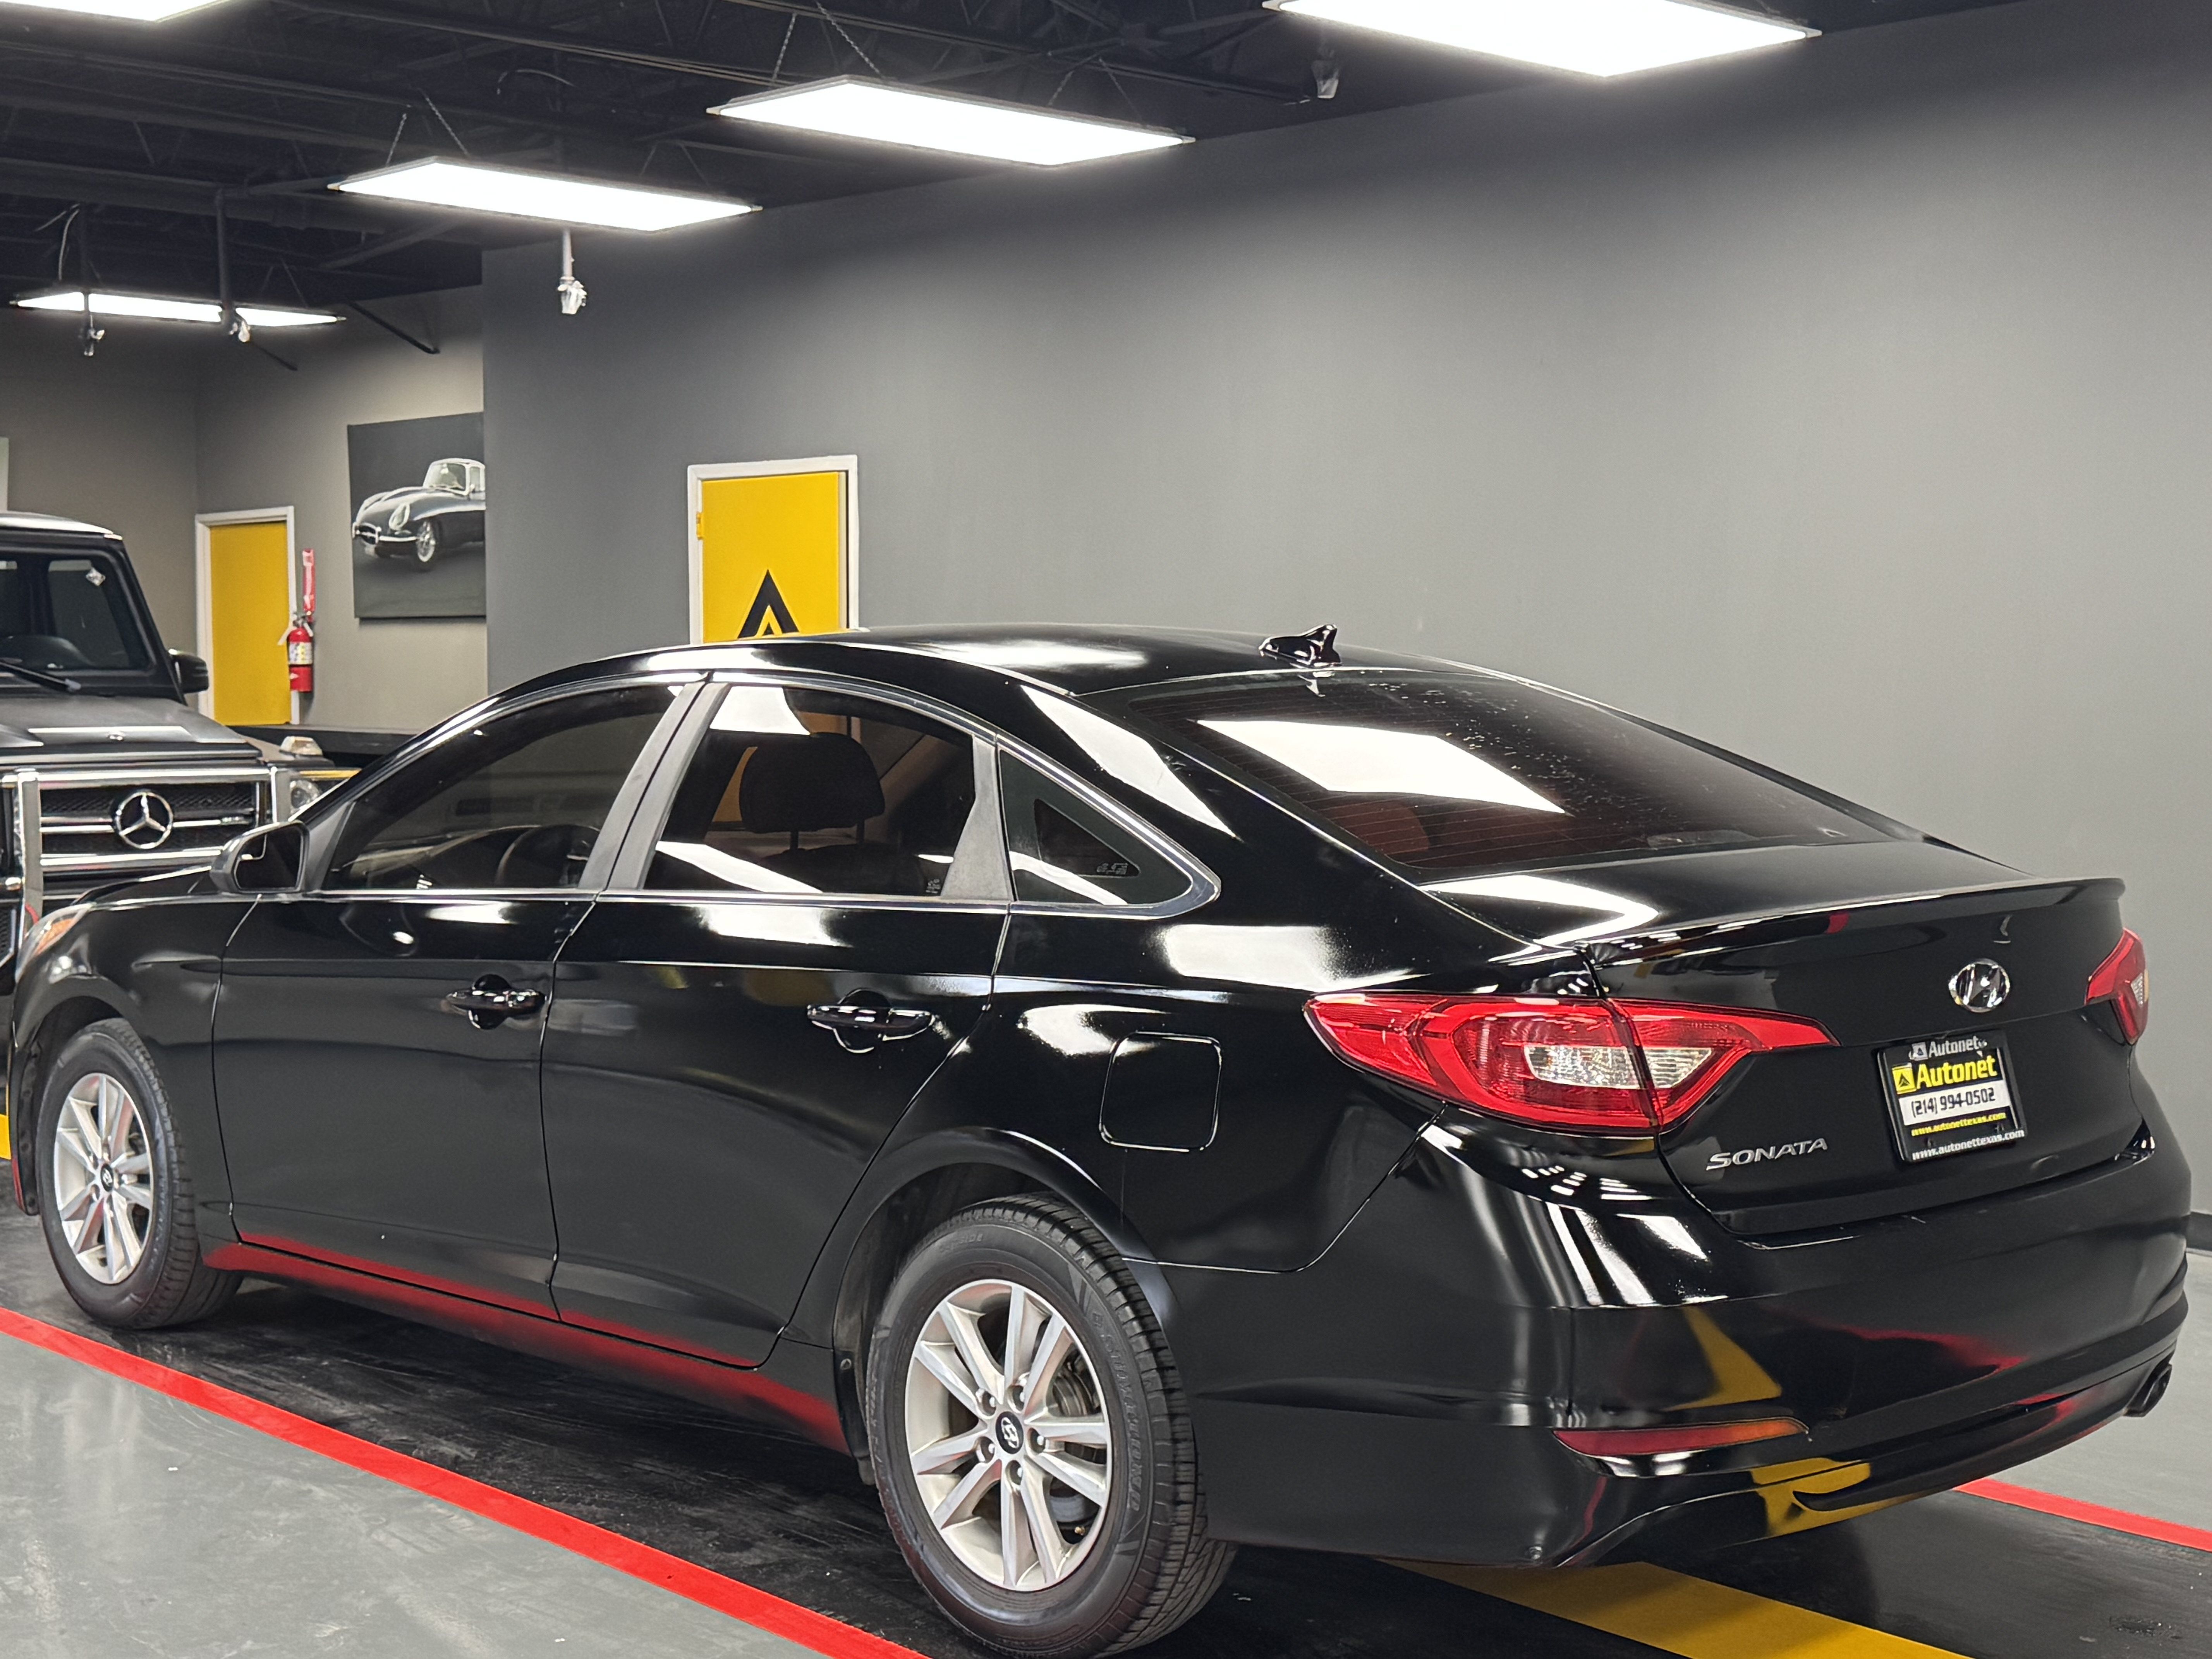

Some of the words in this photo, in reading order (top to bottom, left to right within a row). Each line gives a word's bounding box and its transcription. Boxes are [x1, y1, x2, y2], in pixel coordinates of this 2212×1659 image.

[1929, 1036, 1979, 1058] Autonet
[1917, 1055, 1997, 1090] Autonet
[1911, 1097, 1937, 1118] (214)
[1940, 1087, 1996, 1111] 994-0502
[1706, 1137, 1828, 1171] SONATA
[1912, 1129, 2025, 1161] www.autonettexas.com
